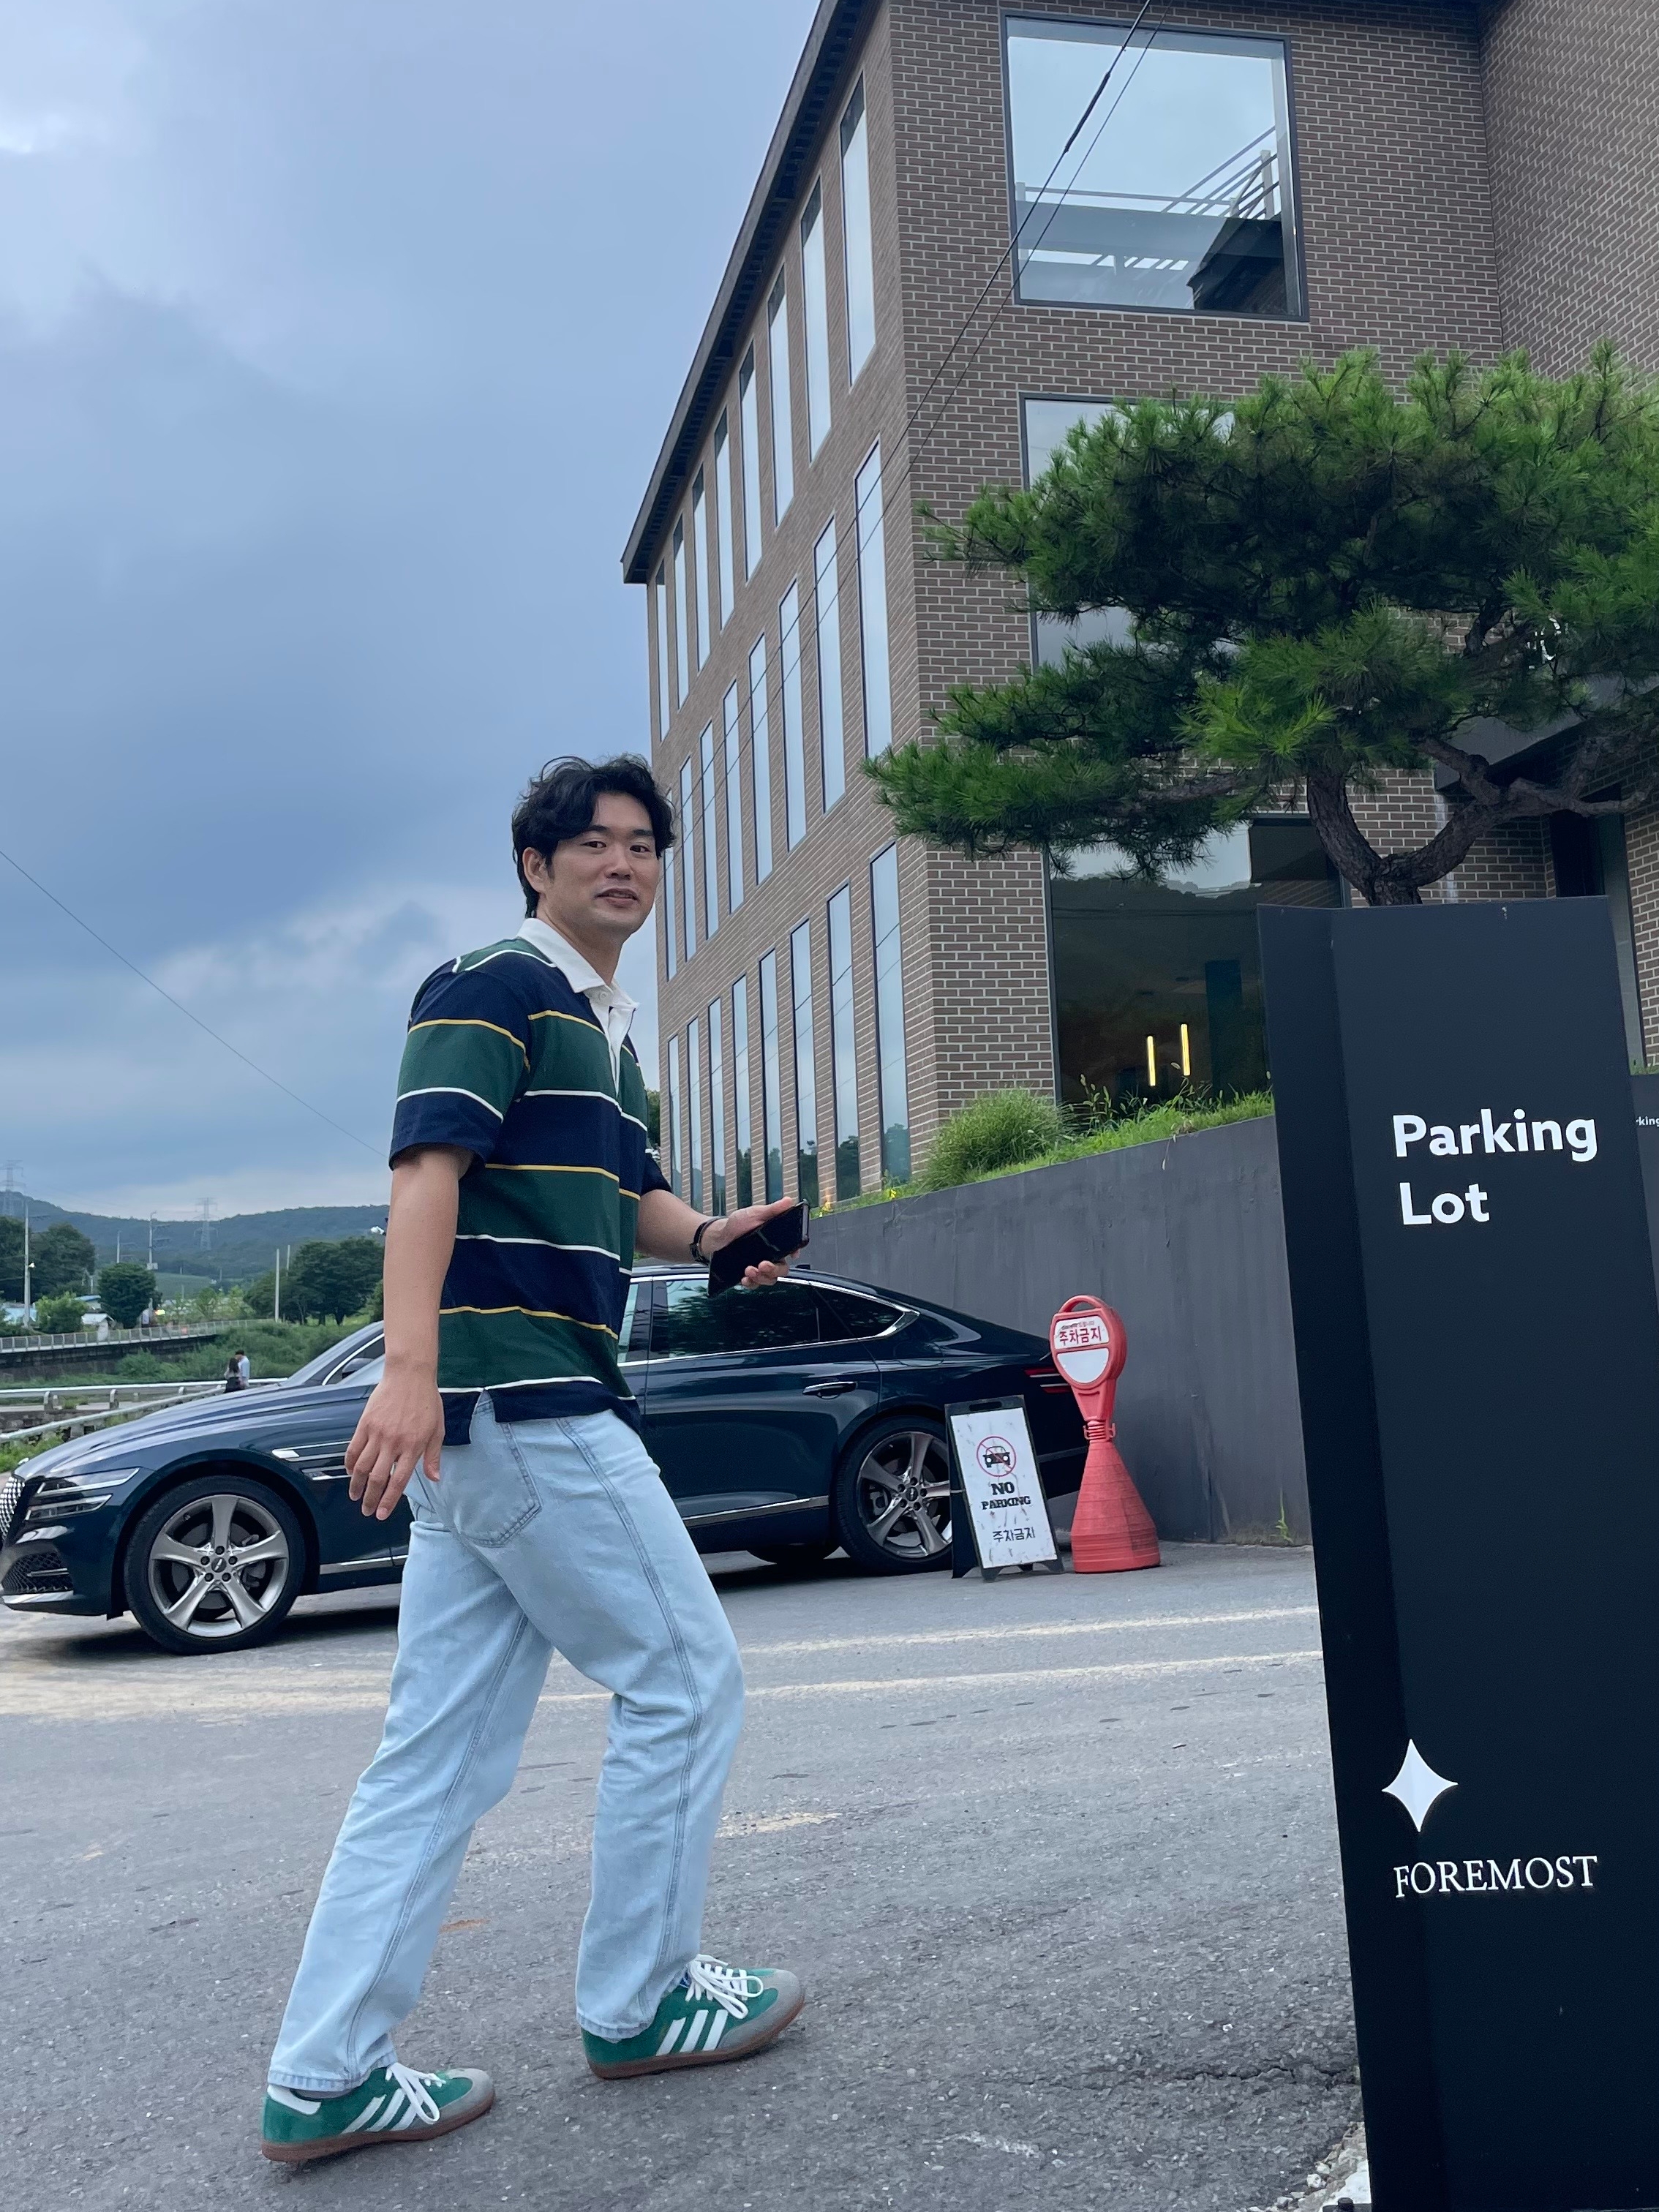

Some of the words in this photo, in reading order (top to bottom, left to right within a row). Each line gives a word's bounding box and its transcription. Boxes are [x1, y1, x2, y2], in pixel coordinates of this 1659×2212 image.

[1393, 1108, 1598, 1162] Parking
[1399, 1182, 1490, 1225] Lot
[1059, 1325, 1102, 1346] 주차금지
[990, 1481, 1015, 1495] NO
[981, 1495, 1031, 1511] PARKING
[992, 1526, 1036, 1543] 주차금지
[1393, 1855, 1598, 1898] FOREMOST
